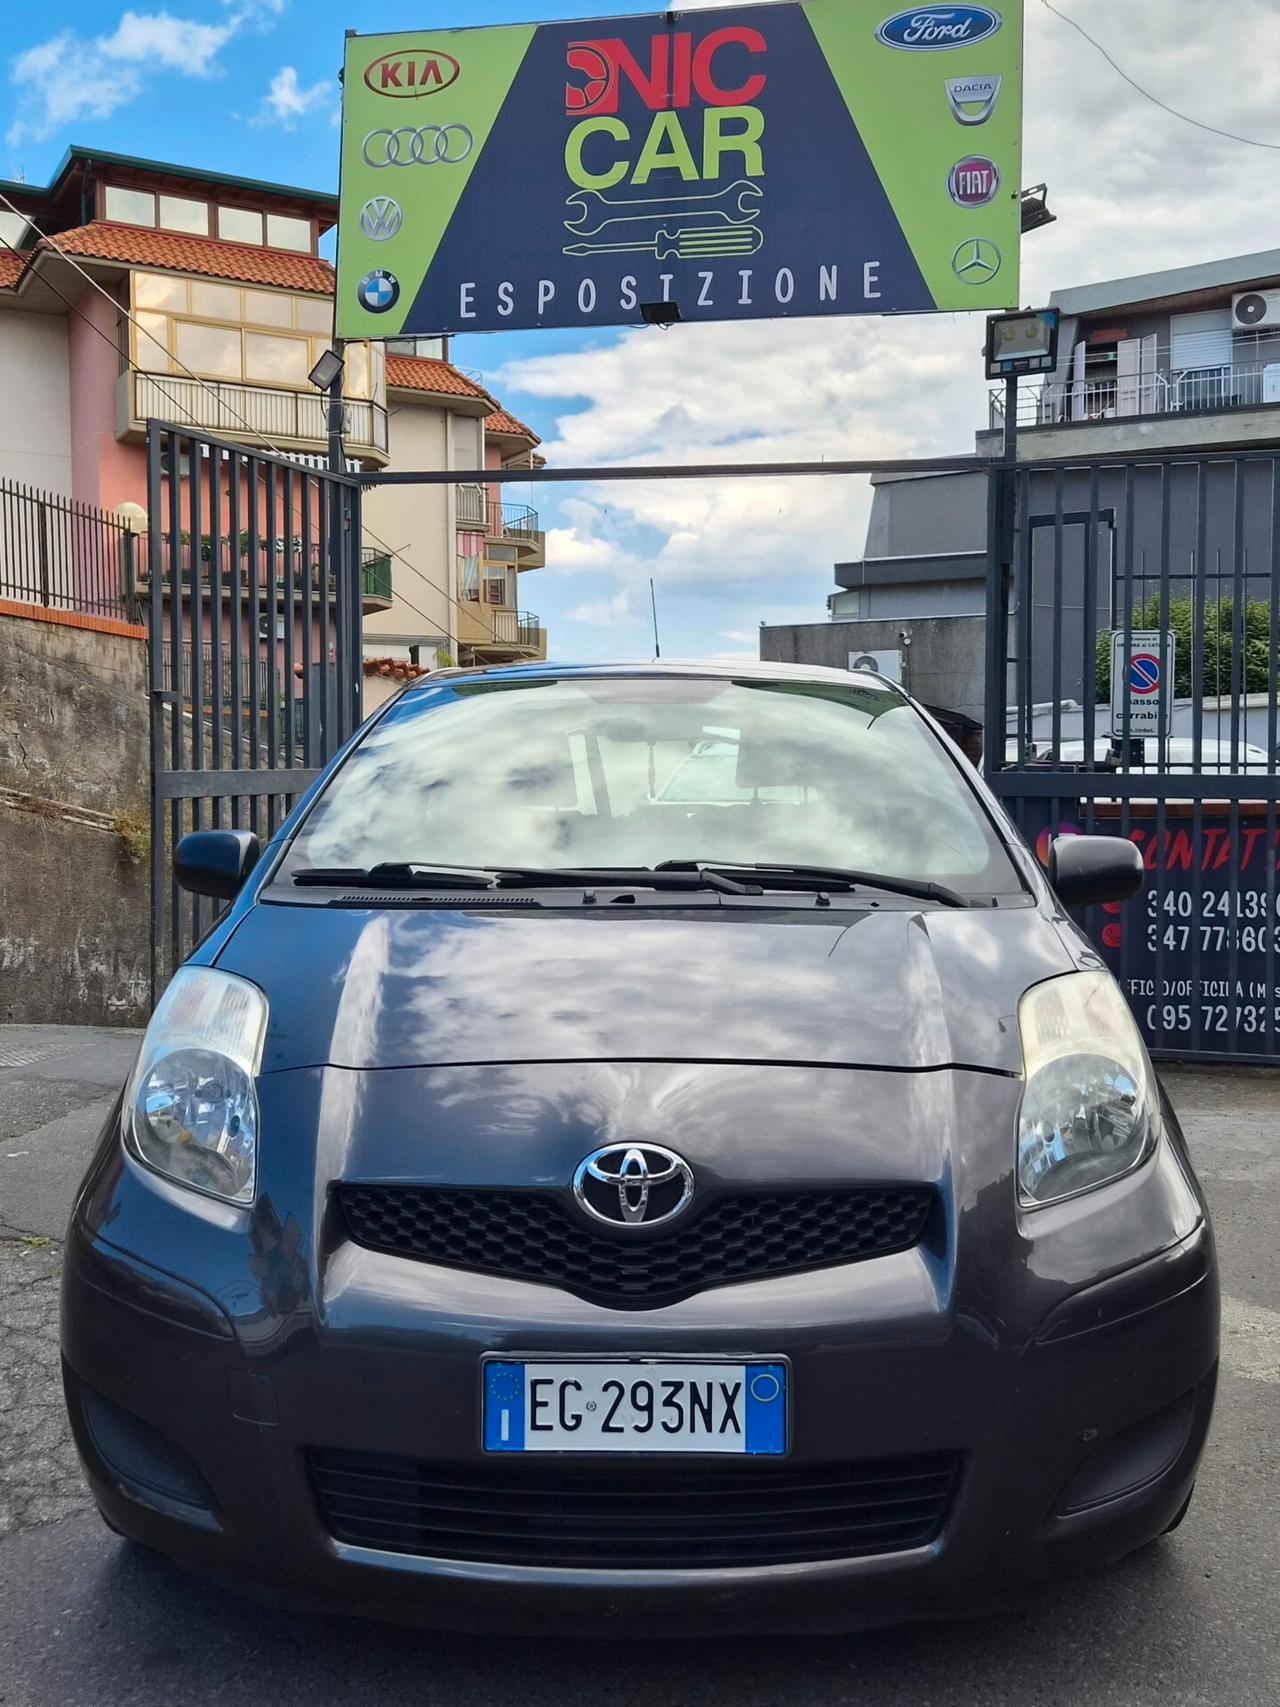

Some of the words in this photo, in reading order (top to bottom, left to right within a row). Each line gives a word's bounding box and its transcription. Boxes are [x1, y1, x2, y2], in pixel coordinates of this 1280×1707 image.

[903, 12, 971, 42] Ford
[380, 59, 443, 88] KIA
[953, 81, 993, 94] DACIA
[564, 105, 765, 190] CAR
[958, 170, 989, 195] FIAT
[460, 261, 881, 318] ESPOSIZIONE
[1147, 889, 1192, 918] 340
[1147, 924, 1191, 952] 347
